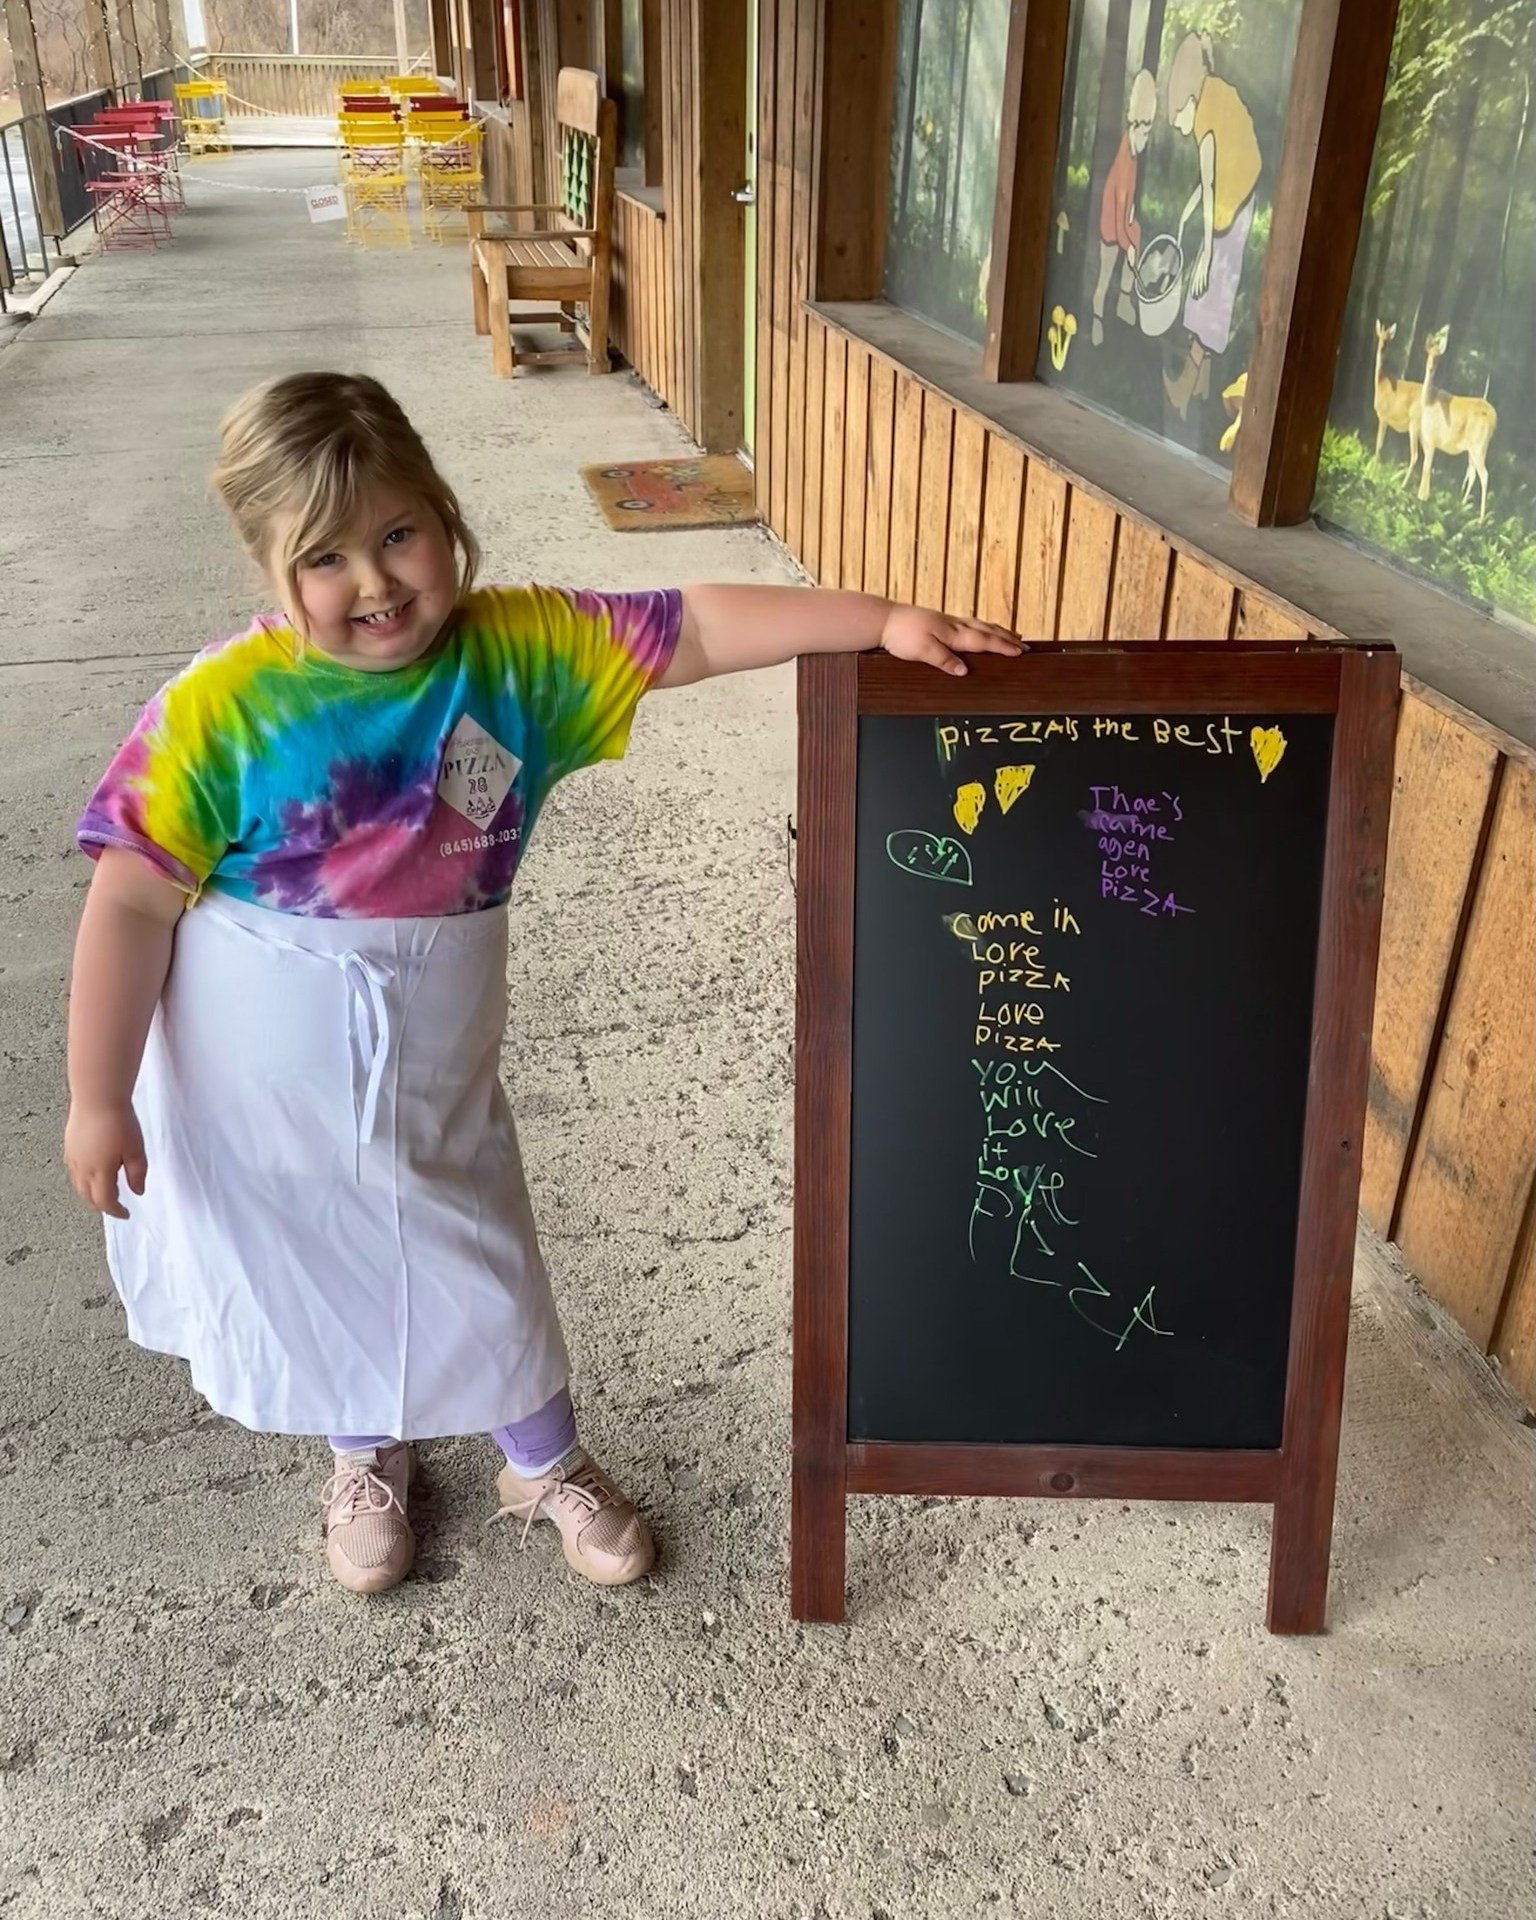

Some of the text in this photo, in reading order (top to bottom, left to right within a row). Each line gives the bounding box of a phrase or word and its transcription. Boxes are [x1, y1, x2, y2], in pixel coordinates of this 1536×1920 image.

[1092, 717, 1139, 741] the
[1153, 716, 1242, 754] Best
[444, 753, 507, 780] PIZZA
[1053, 898, 1081, 935] in
[983, 1137, 1009, 1161] it
